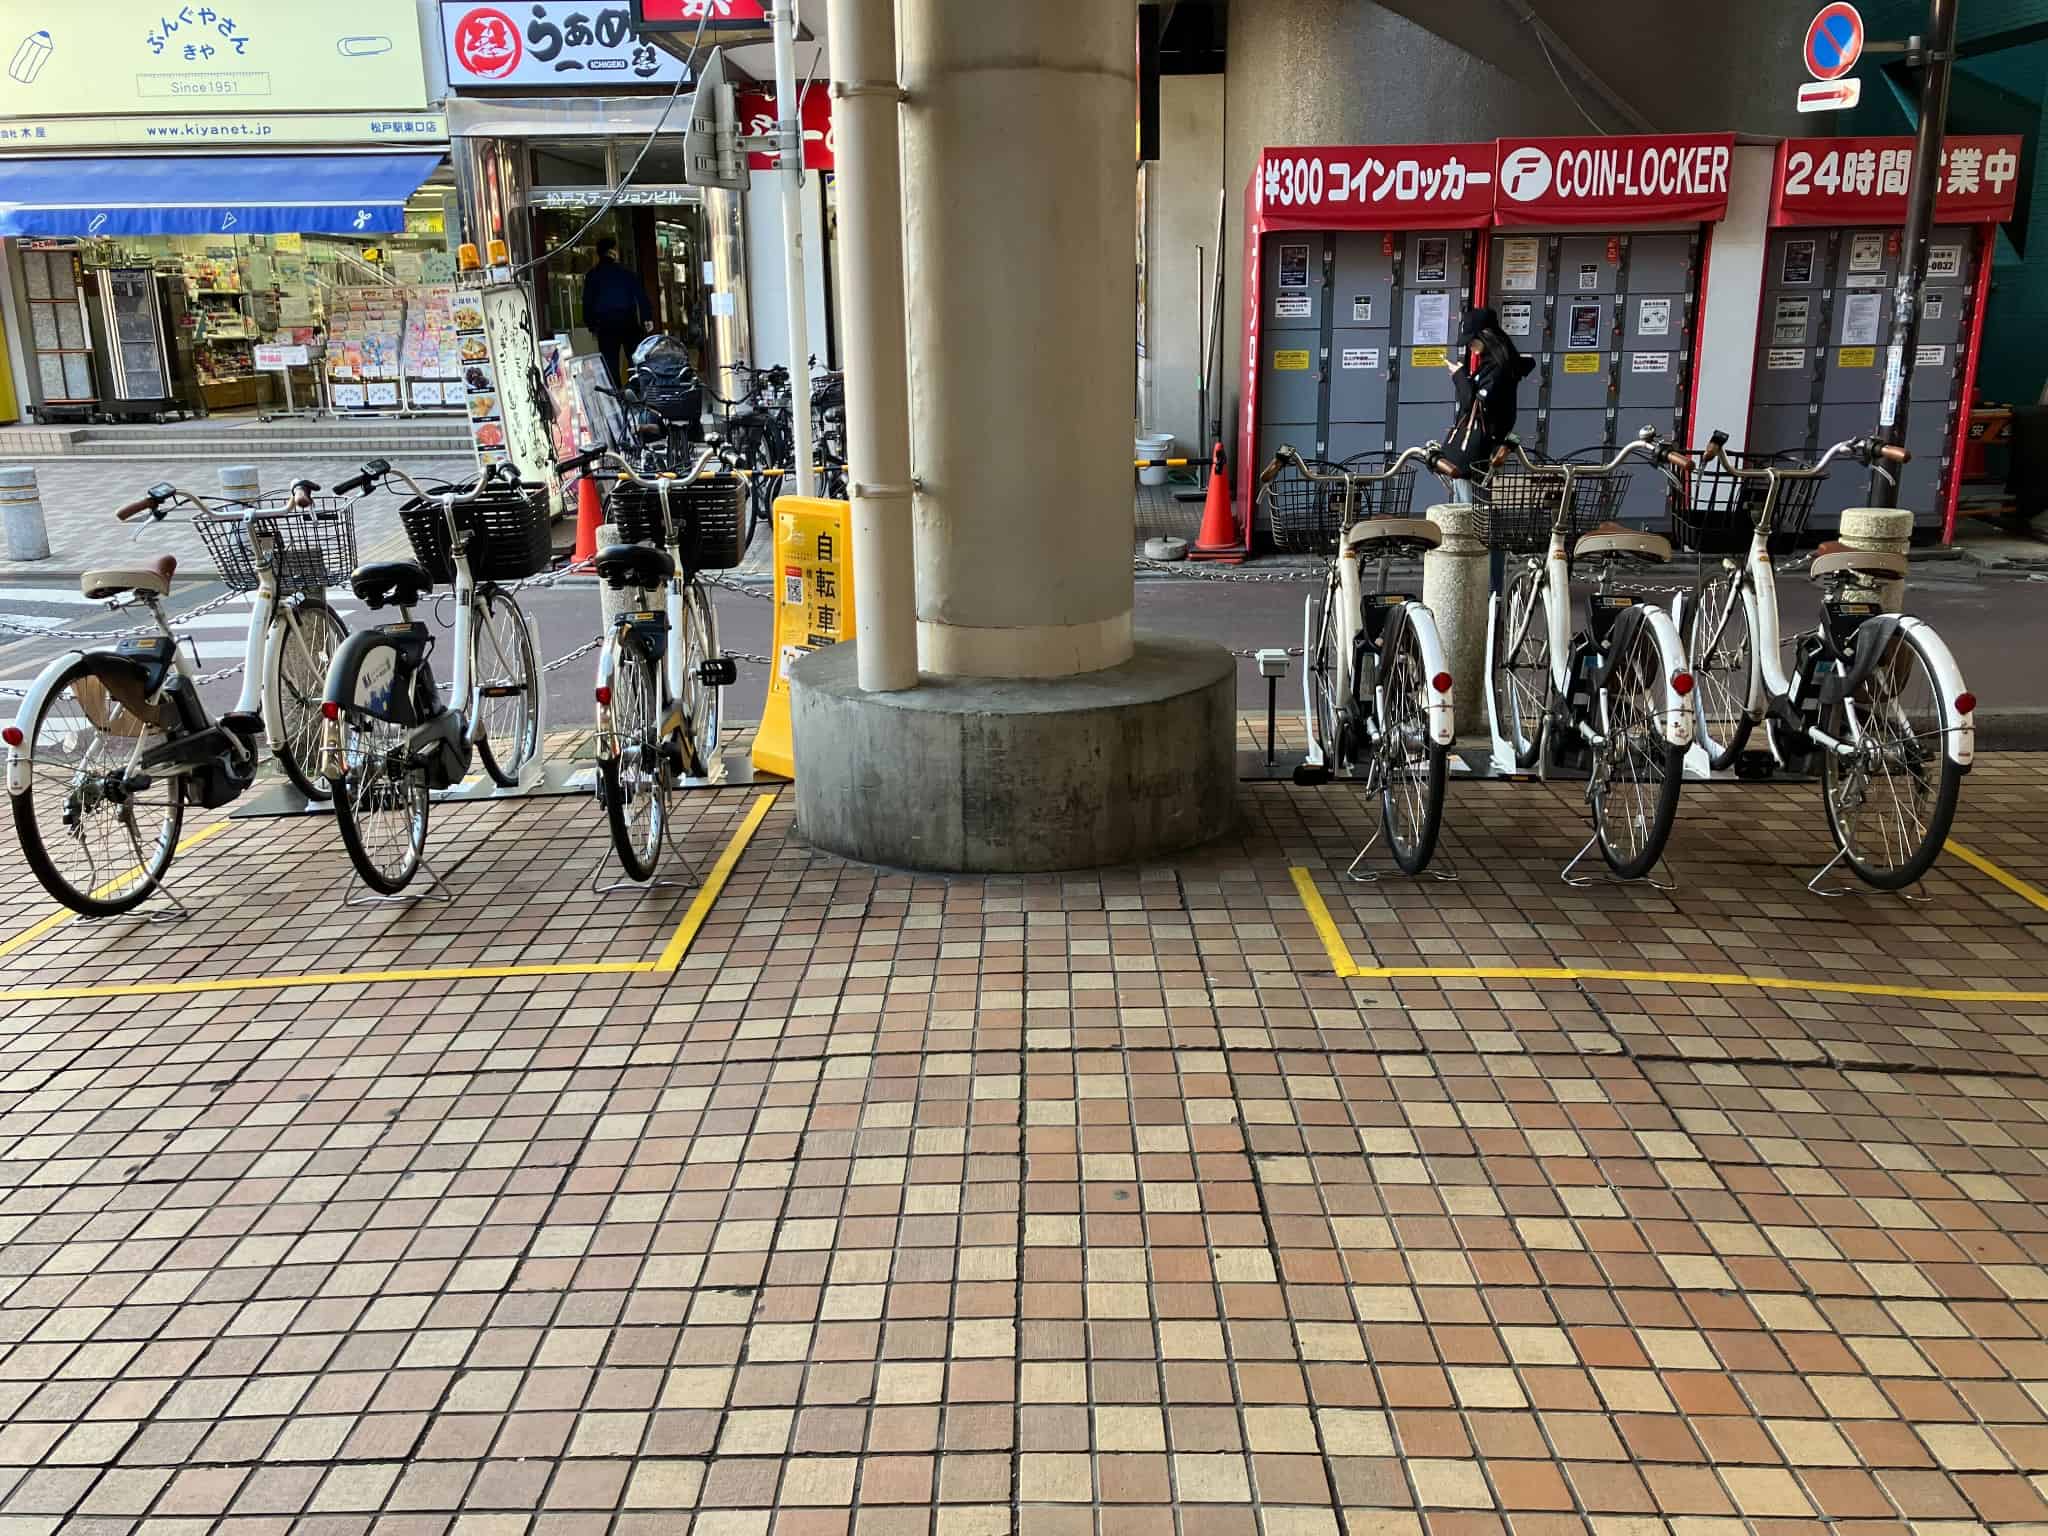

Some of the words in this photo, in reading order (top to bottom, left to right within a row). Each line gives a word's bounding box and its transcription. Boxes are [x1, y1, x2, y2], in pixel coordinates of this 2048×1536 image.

[146, 6, 249, 54] ぶんぐやさん
[183, 43, 215, 60] きや
[526, 3, 650, 62] らあめ
[590, 60, 626, 69] ICHIGEKI
[146, 122, 273, 136] www.kiyanet.jp
[371, 120, 437, 133] 松戸駅東口店
[1328, 156, 1492, 203] コインロッカー
[1555, 146, 1729, 198] COIN-LOCKER
[1784, 148, 2018, 197] 24時間業中
[815, 531, 836, 634] 自転車
